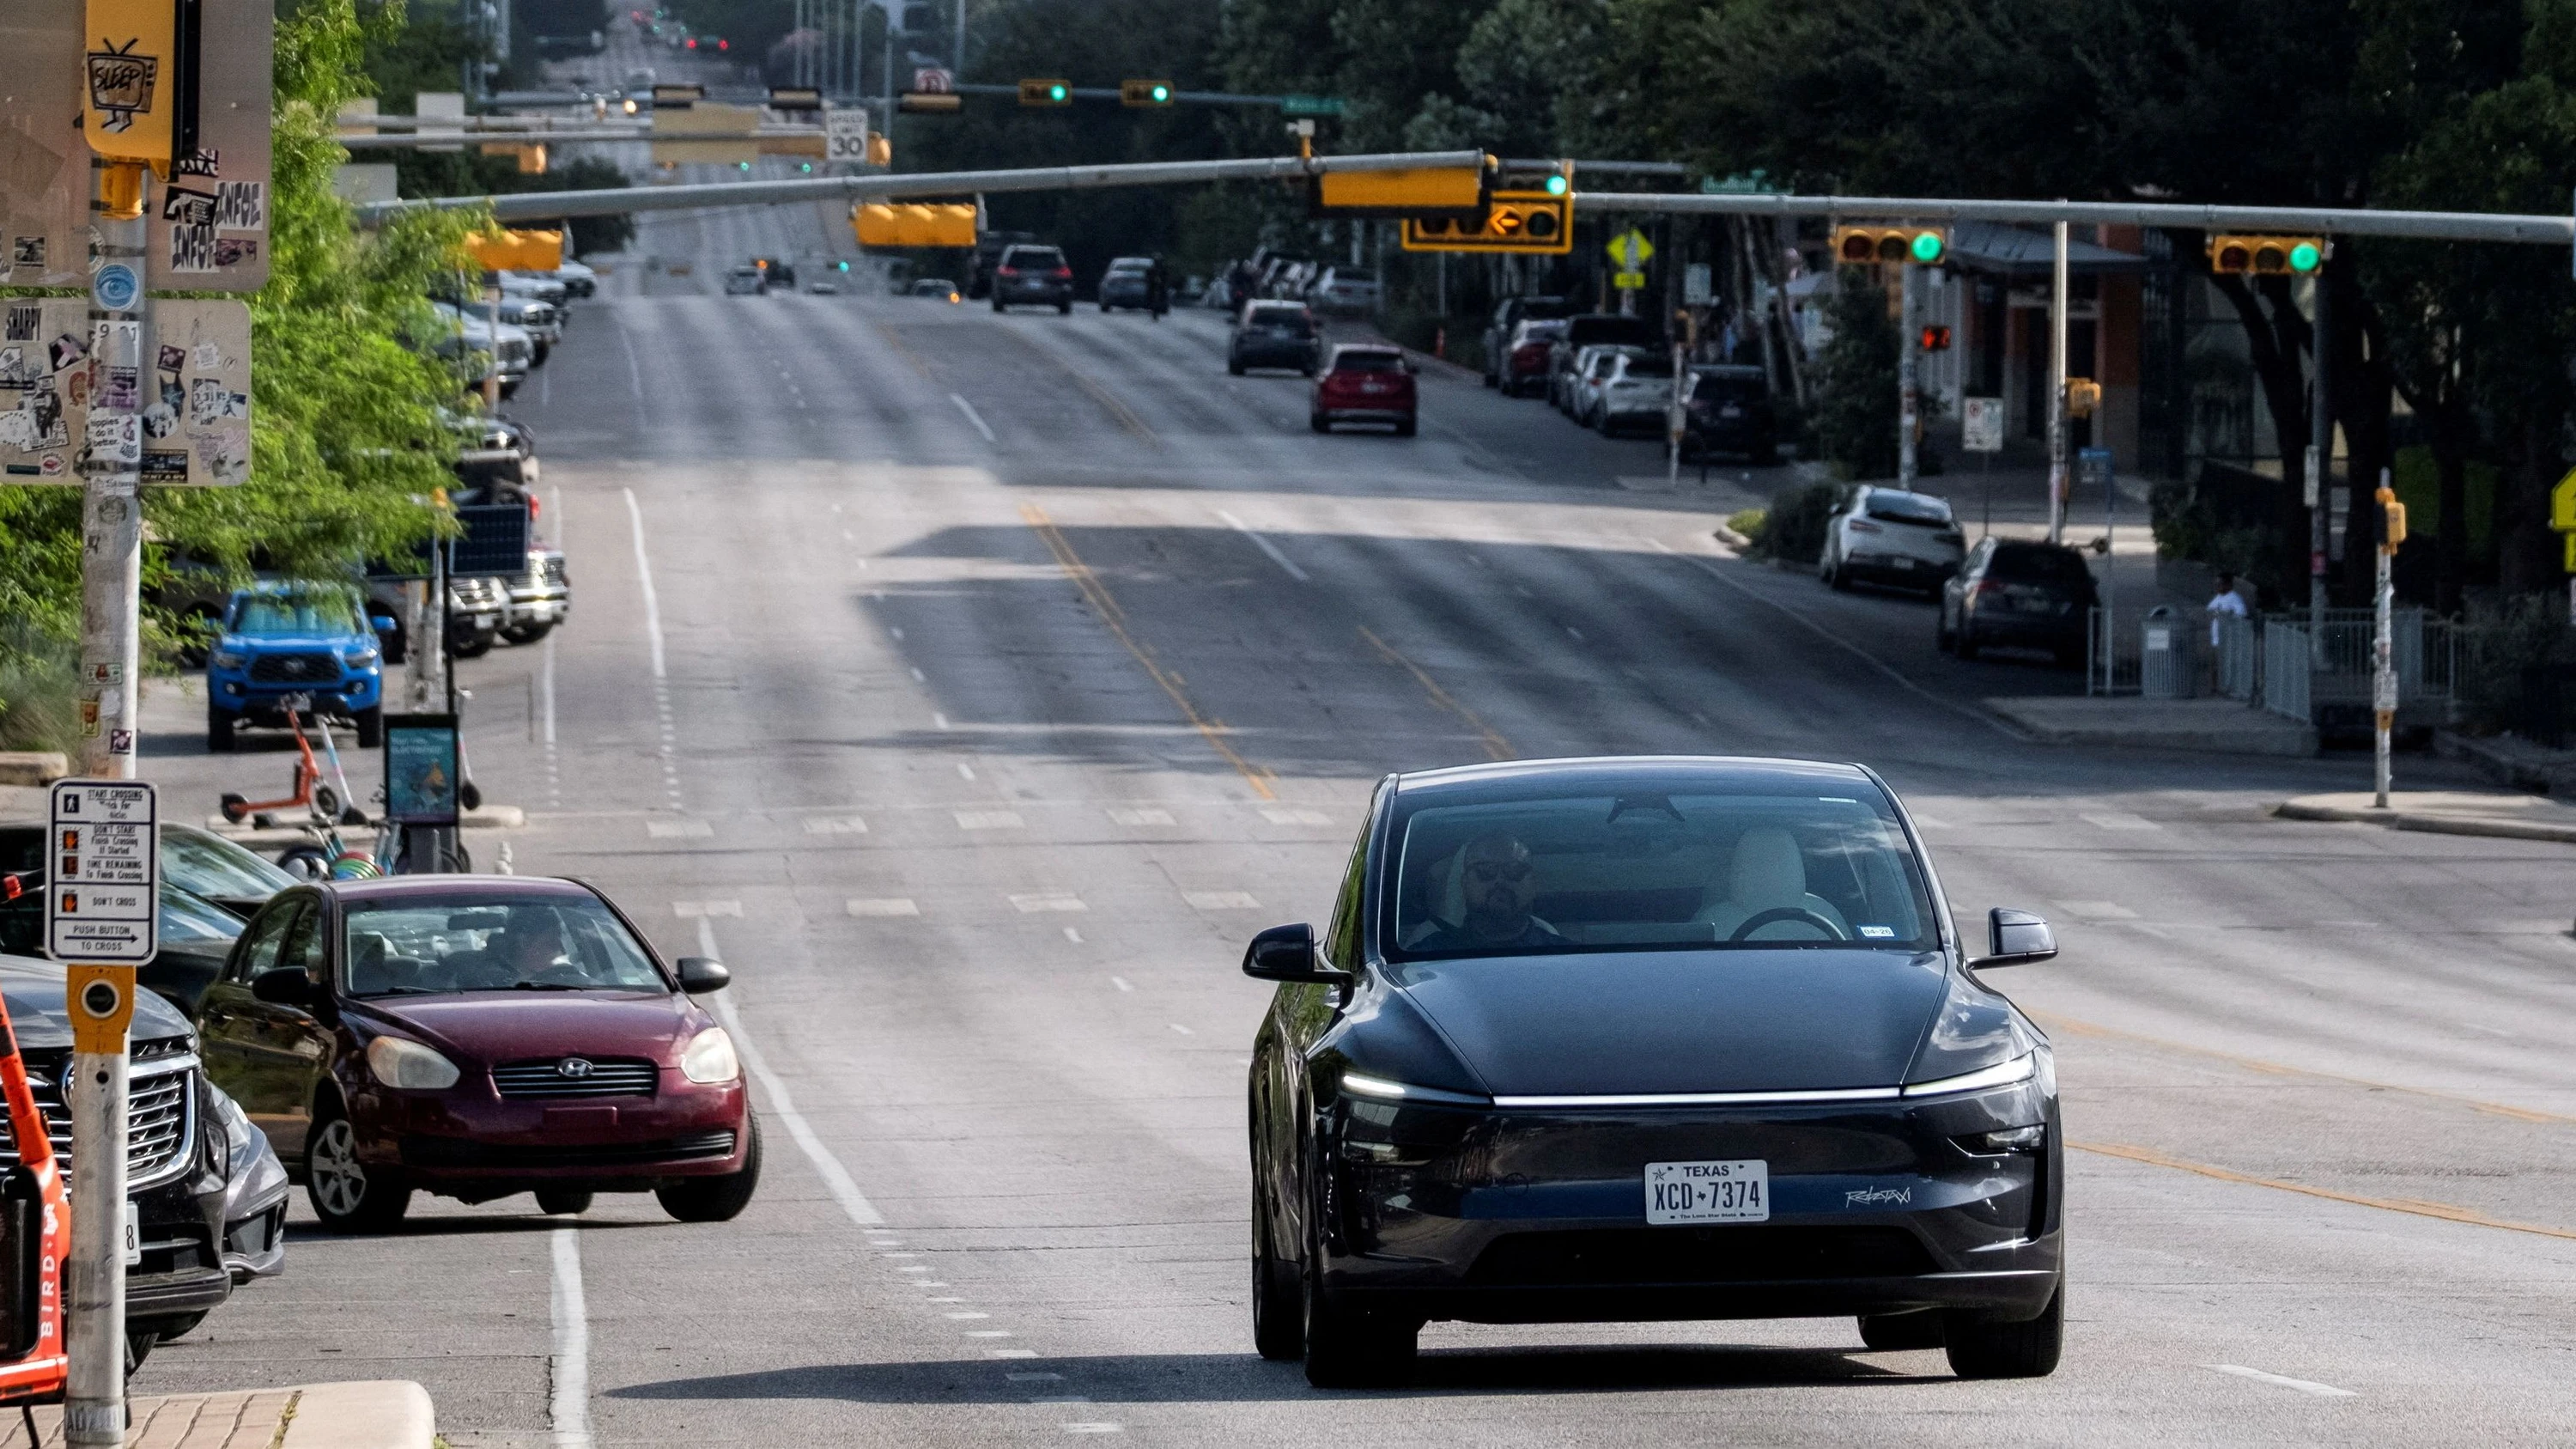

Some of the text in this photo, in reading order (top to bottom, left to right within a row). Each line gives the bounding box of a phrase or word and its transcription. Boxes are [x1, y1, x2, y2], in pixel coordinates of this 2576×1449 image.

[95, 64, 141, 91] SLEEP
[831, 136, 863, 155] 30
[111, 789, 143, 799] CROSSING
[116, 825, 136, 834] START
[112, 836, 138, 848] Crossing
[105, 860, 143, 869] REMAINING
[93, 897, 137, 907] DON'T CROSS
[73, 925, 131, 935] PUSH BUTTON
[81, 941, 123, 953] TO CROSS
[1682, 1165, 1730, 1178] TEXAS
[1654, 1180, 1761, 1212] XCD 7374
[40, 1254, 56, 1338] BIRD
